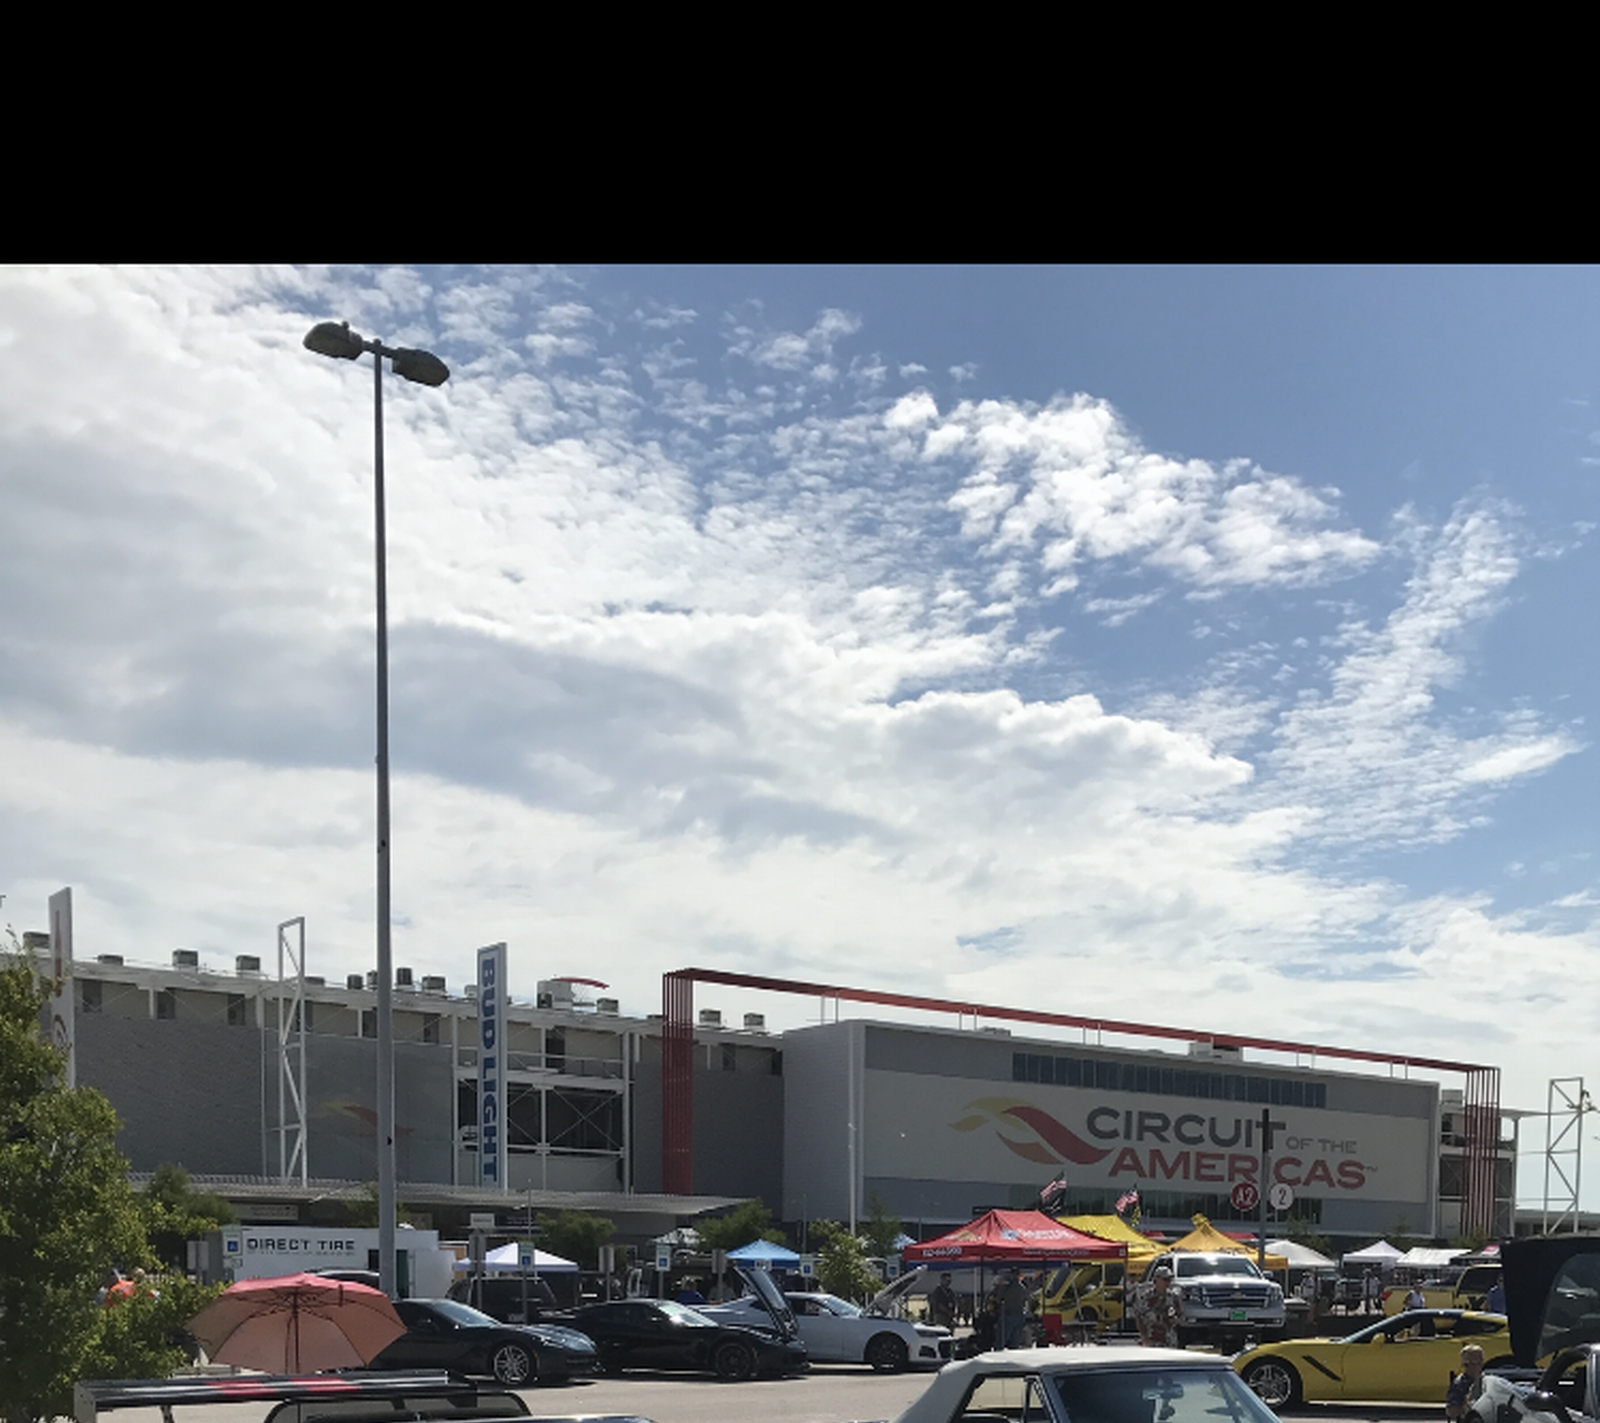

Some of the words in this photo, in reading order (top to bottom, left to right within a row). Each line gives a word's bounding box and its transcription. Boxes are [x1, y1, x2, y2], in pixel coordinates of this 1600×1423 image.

[482, 957, 496, 1050] BUD
[482, 1056, 497, 1182] LIGHT
[1086, 1106, 1286, 1149] CIRCUIT
[1286, 1136, 1313, 1150] OF
[1318, 1139, 1357, 1154] THE
[1278, 1188, 1287, 1206] 2
[247, 1238, 310, 1251] DIRECT
[317, 1240, 355, 1251] TIRE
